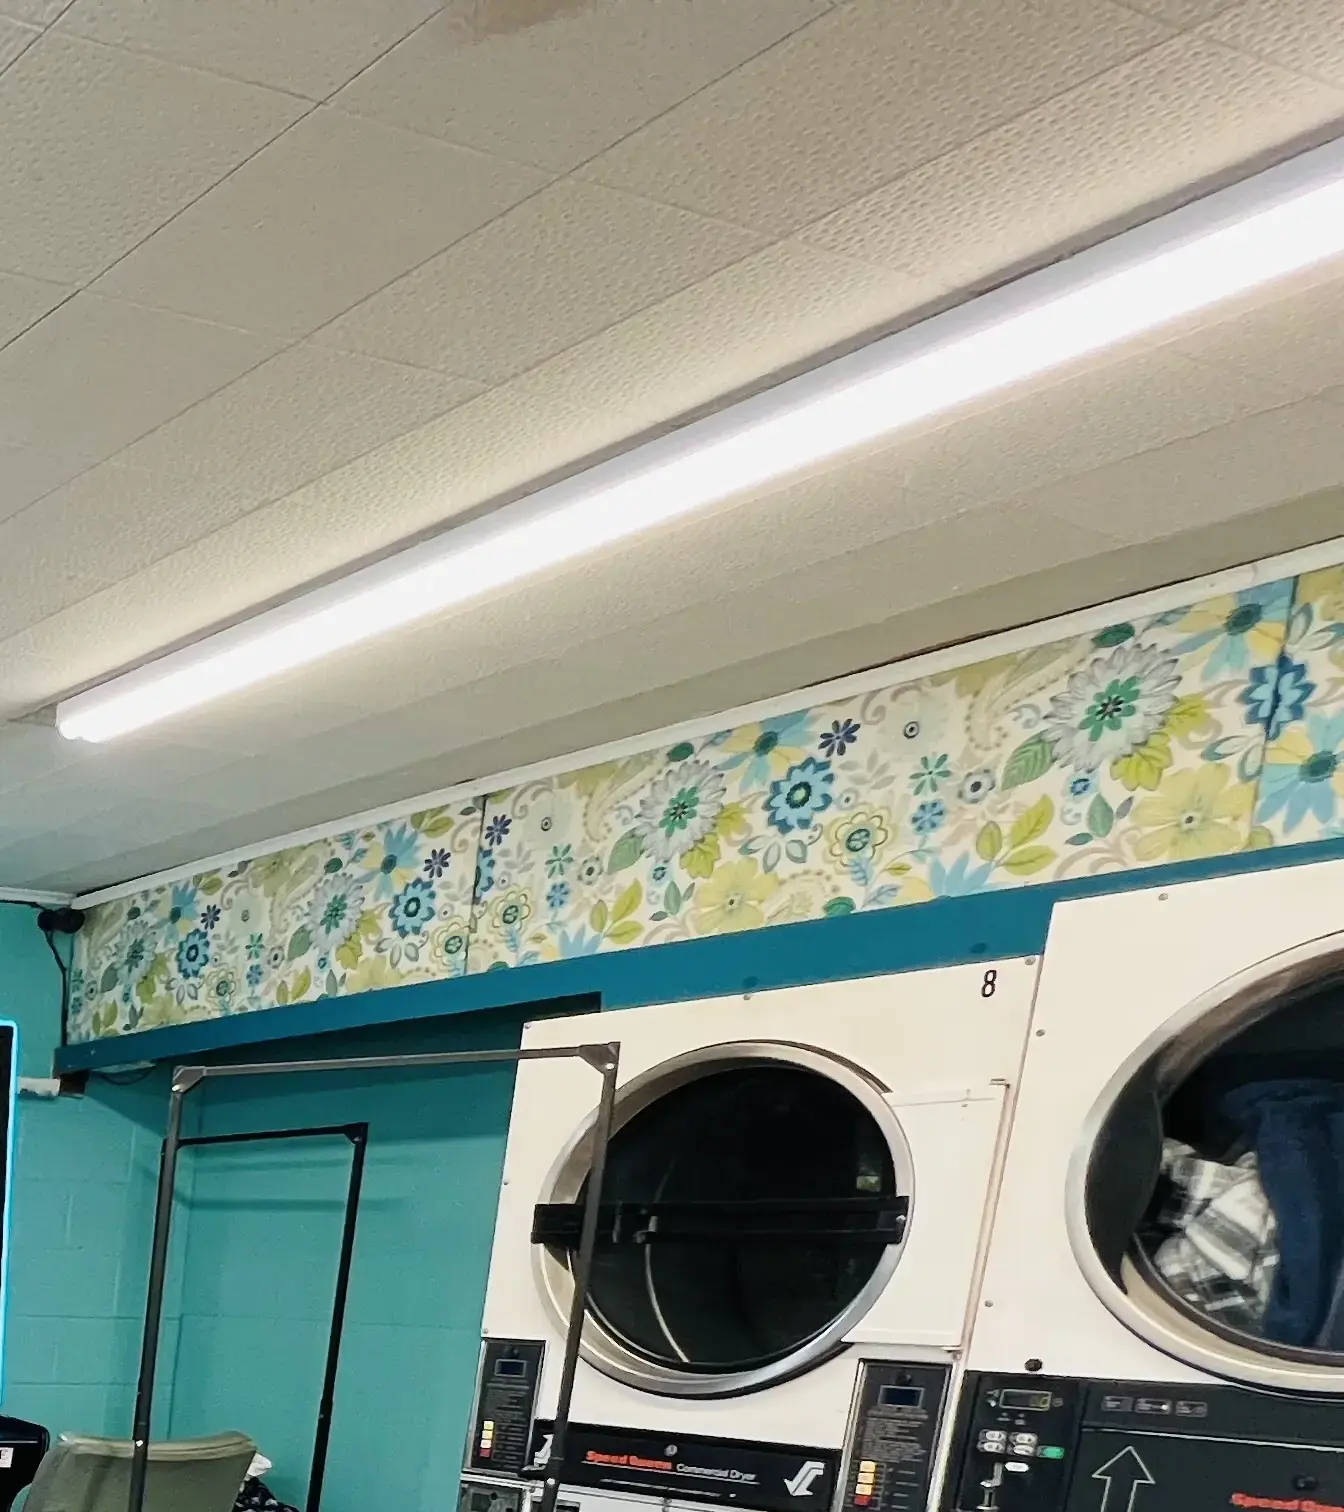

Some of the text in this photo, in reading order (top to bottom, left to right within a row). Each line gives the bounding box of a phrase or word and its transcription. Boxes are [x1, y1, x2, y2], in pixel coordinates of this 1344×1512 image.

[980, 969, 998, 998] 8
[585, 1450, 628, 1466] Speed
[729, 1469, 757, 1481] Dryer
